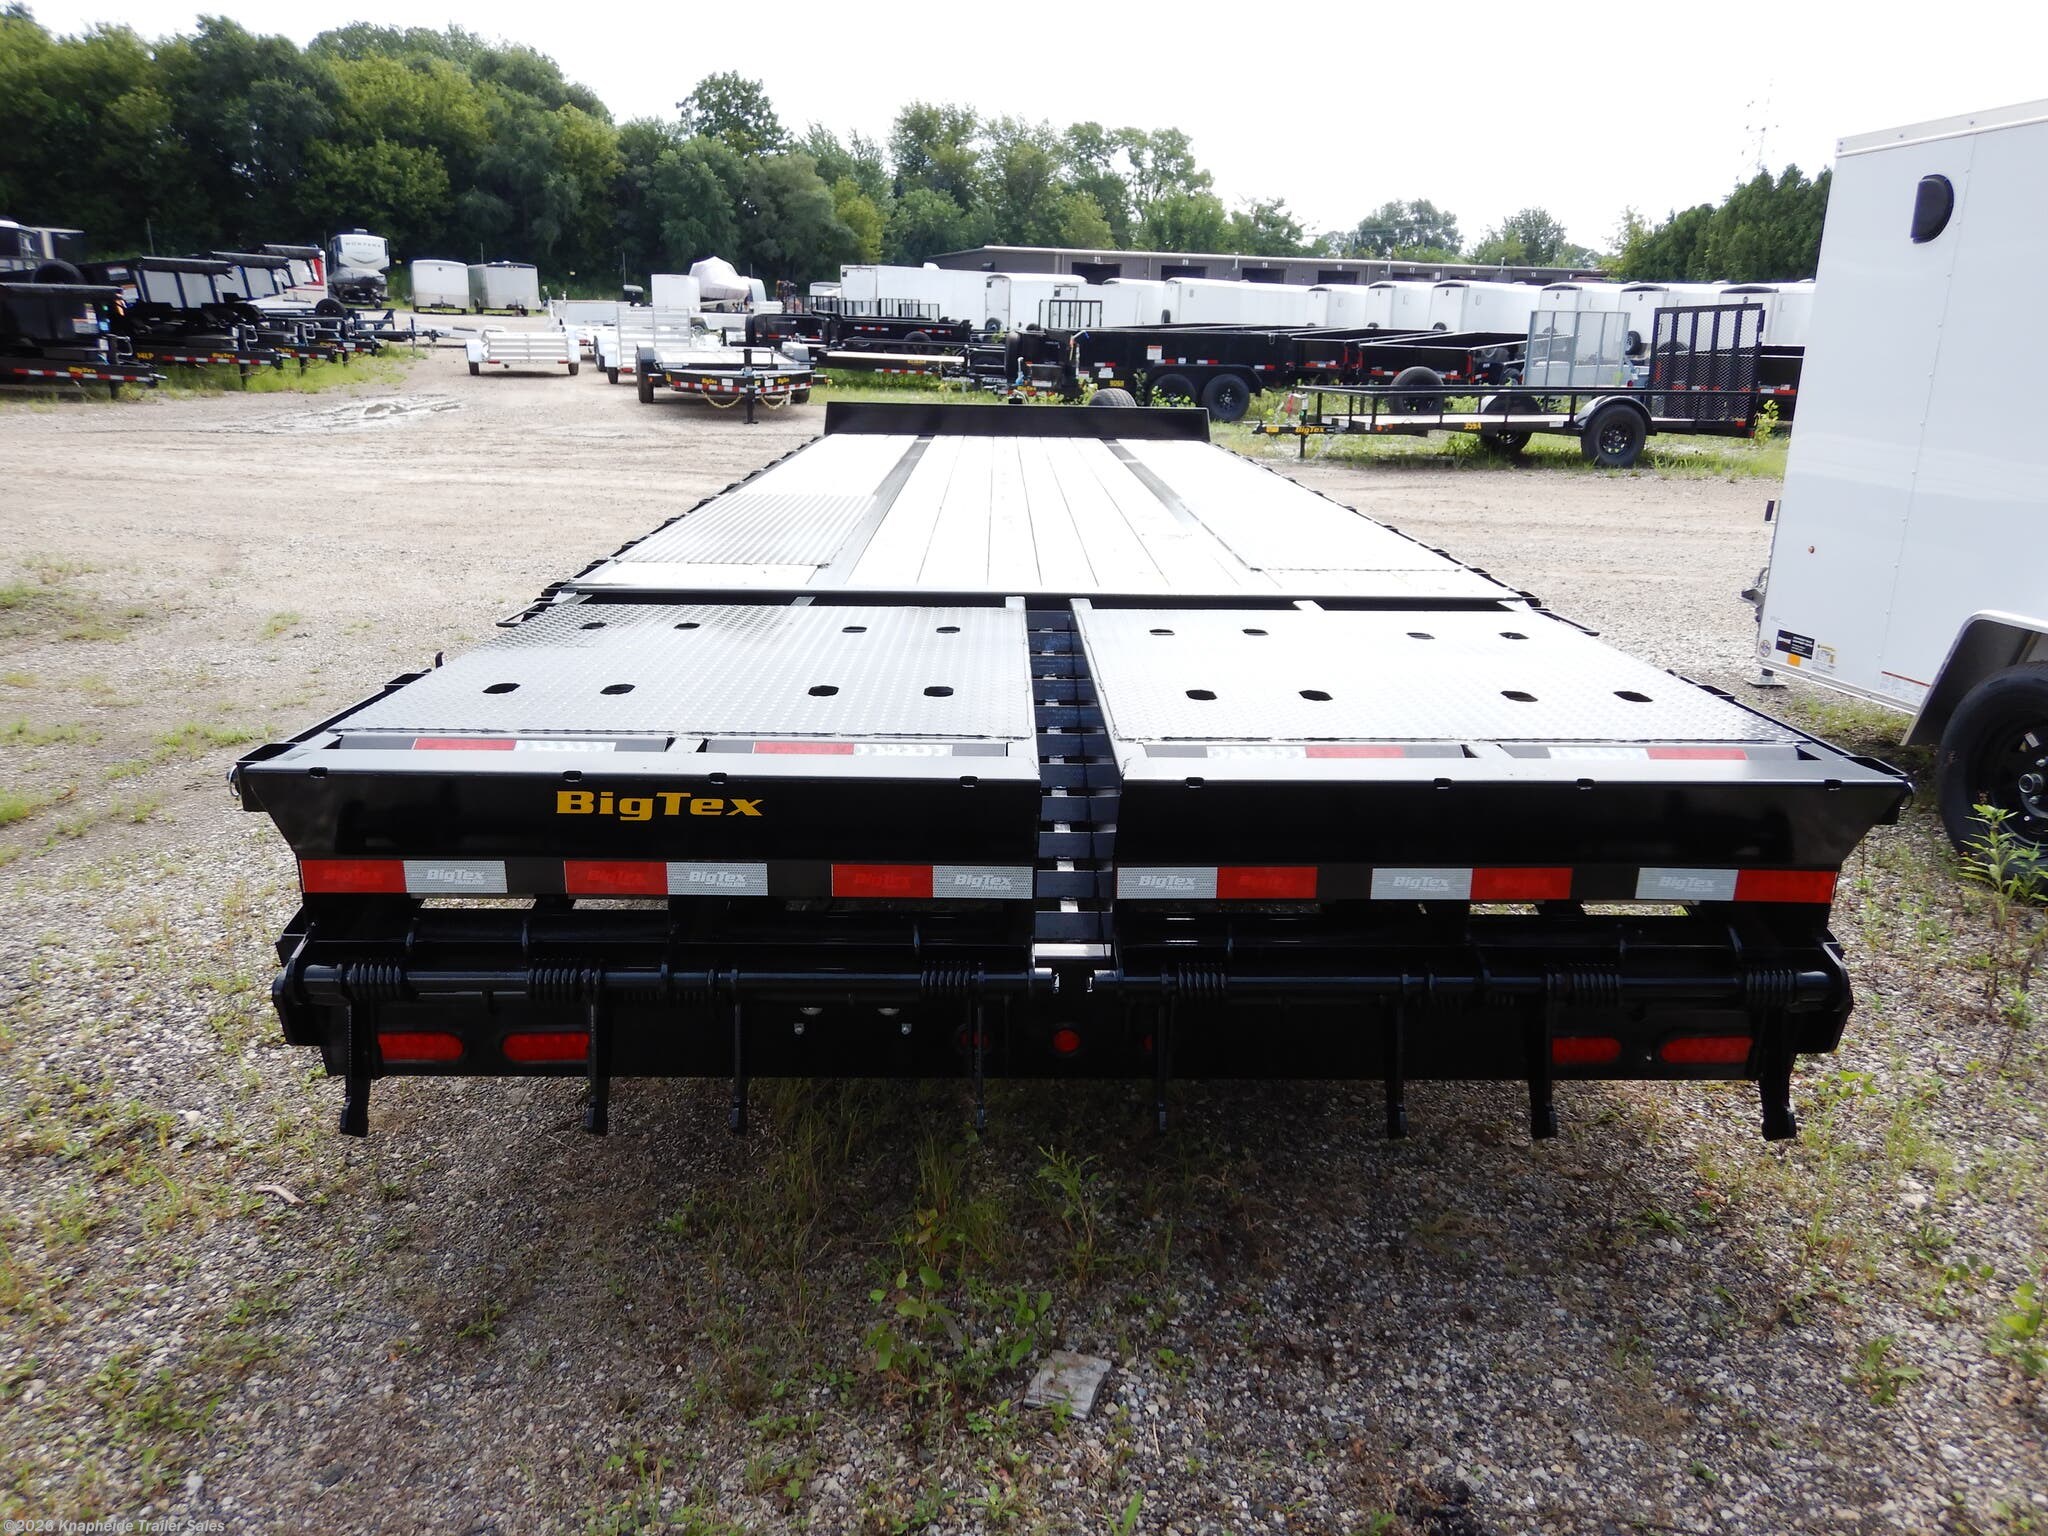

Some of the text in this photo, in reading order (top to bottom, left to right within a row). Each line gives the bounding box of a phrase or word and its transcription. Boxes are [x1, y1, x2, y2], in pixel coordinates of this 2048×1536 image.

[1294, 425, 1325, 435] BigTex
[556, 790, 765, 821] BigTex
[426, 869, 485, 882] BigTex
[689, 871, 747, 885] BigTex
[954, 874, 1012, 888] BigTex
[1138, 875, 1196, 889] BigTex
[1392, 876, 1449, 889] BigTex
[1658, 876, 1715, 890] BigTex
